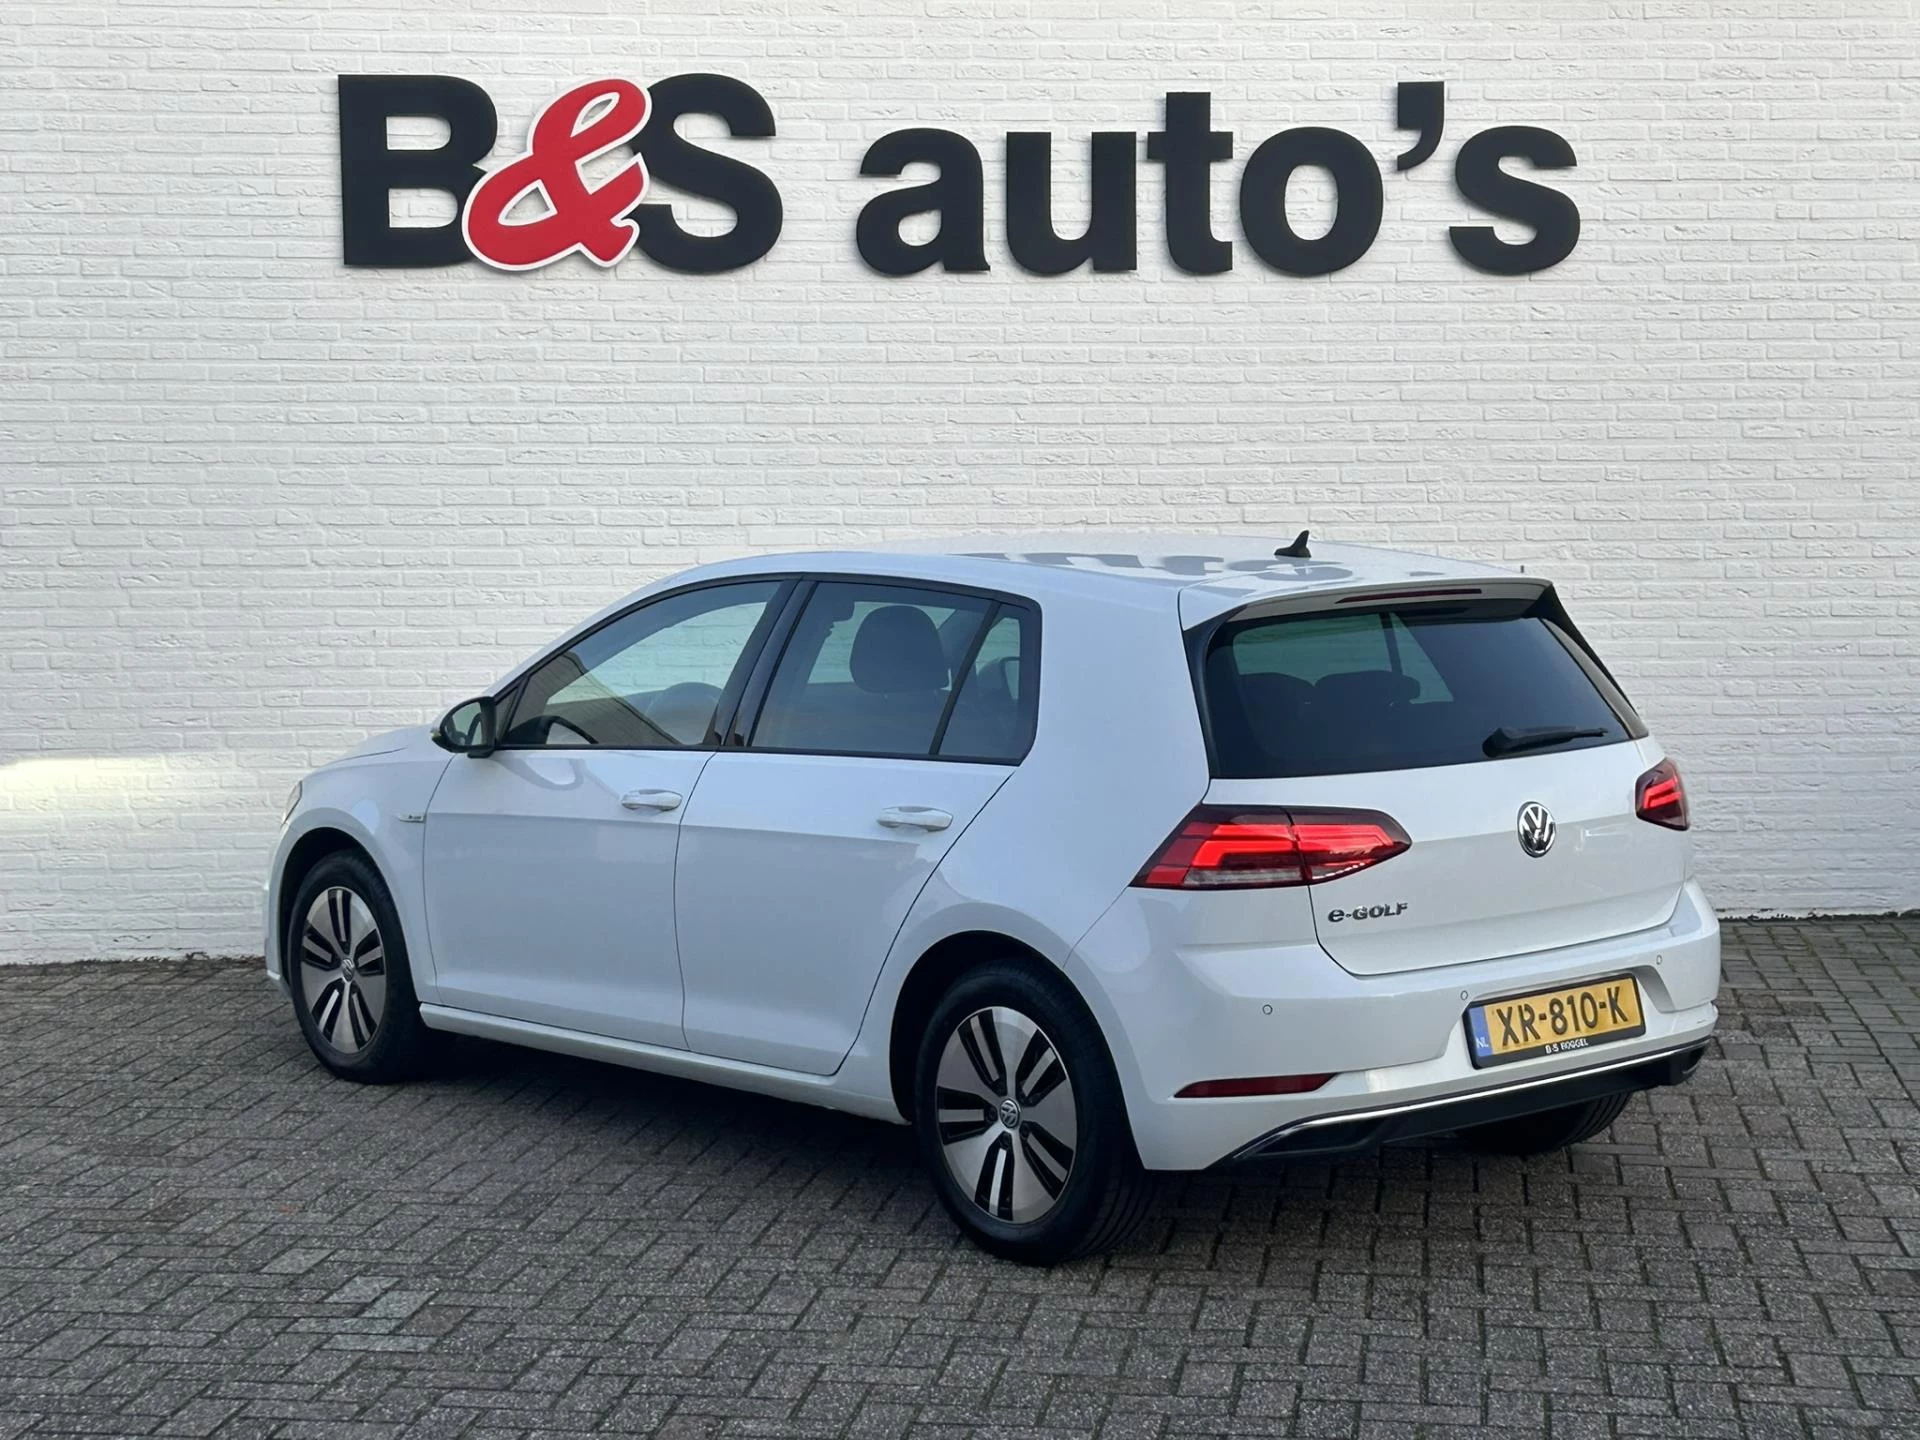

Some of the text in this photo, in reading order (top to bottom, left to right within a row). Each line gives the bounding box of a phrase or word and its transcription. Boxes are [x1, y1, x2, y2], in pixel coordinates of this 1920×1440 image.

[338, 73, 1581, 276] B&S auto's
[1328, 902, 1408, 922] e-GOLF
[1496, 986, 1628, 1046] XR-810-K
[1475, 1037, 1489, 1048] NL
